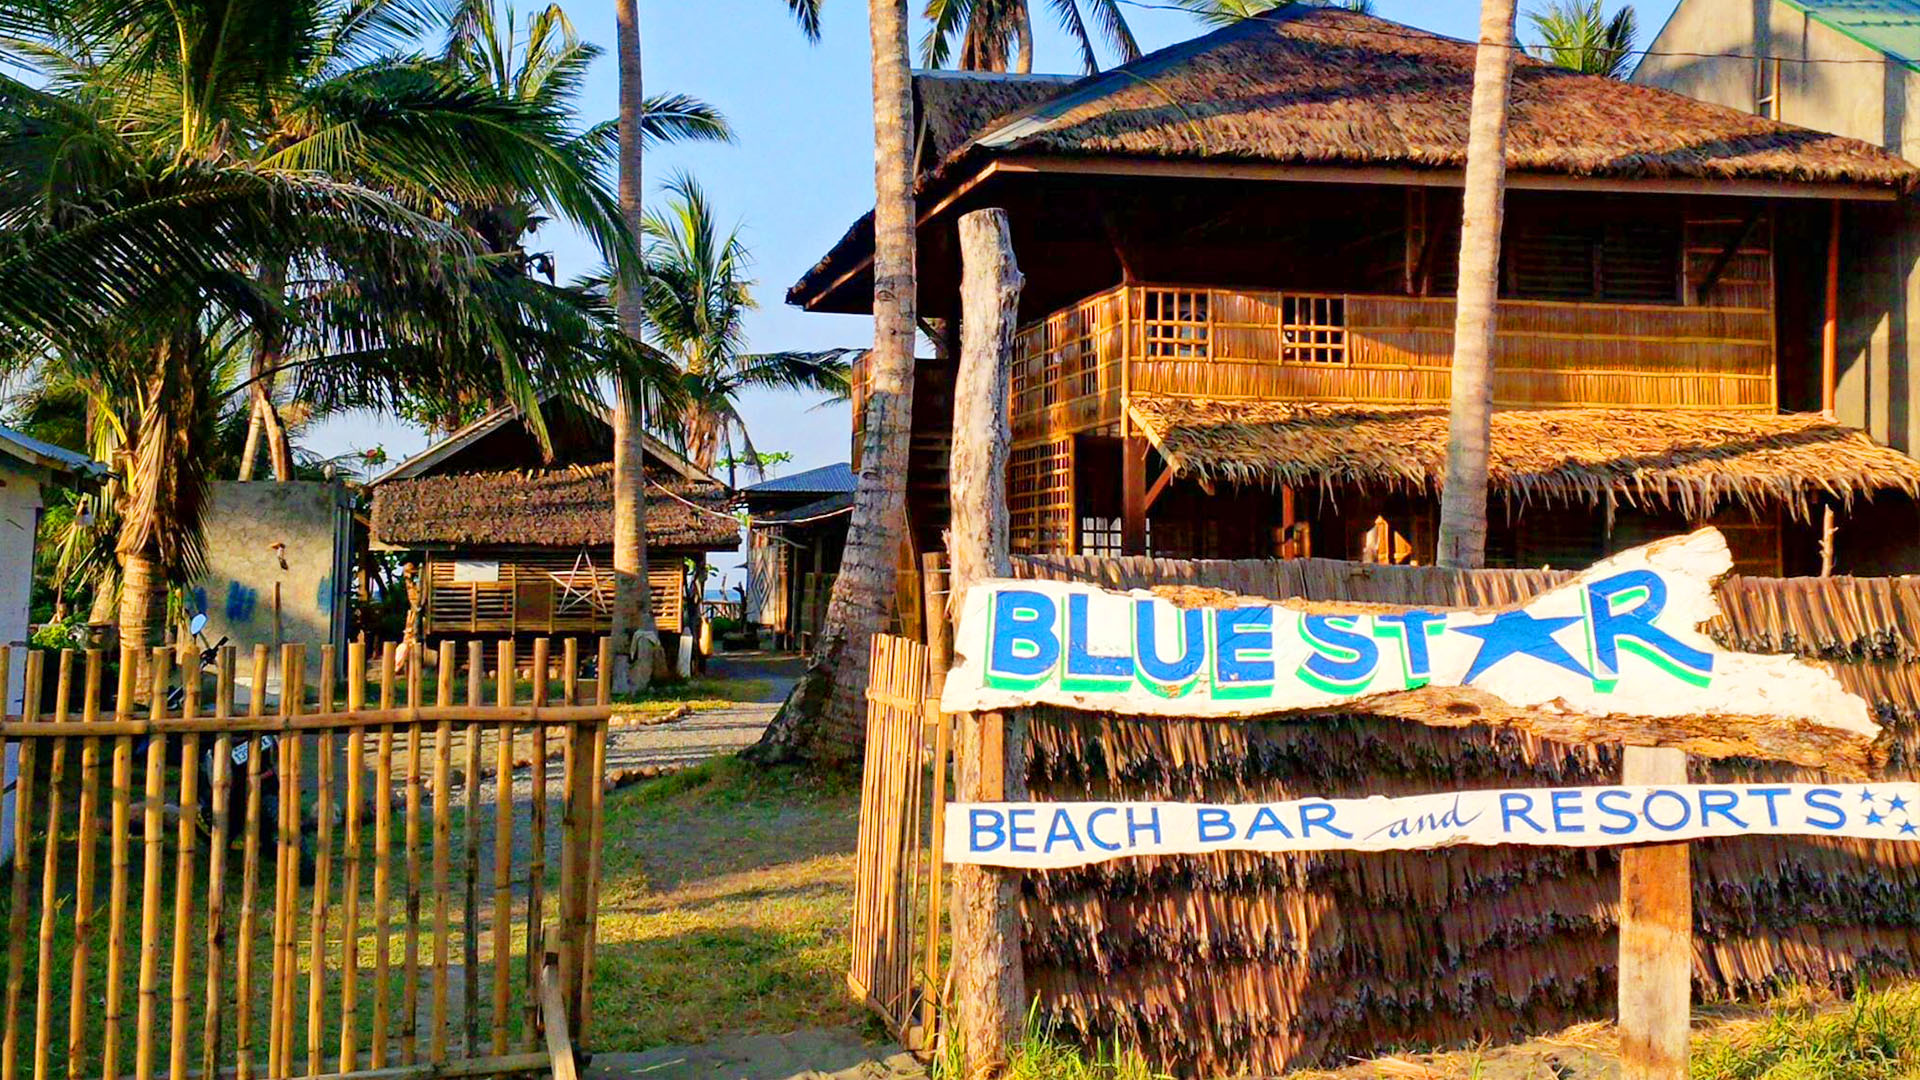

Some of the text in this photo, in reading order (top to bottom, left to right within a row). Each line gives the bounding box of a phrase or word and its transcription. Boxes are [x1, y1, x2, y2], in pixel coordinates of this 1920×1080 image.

[985, 589, 1276, 699] BLUE
[968, 788, 1848, 853] BEACH BAR and RESORTS
